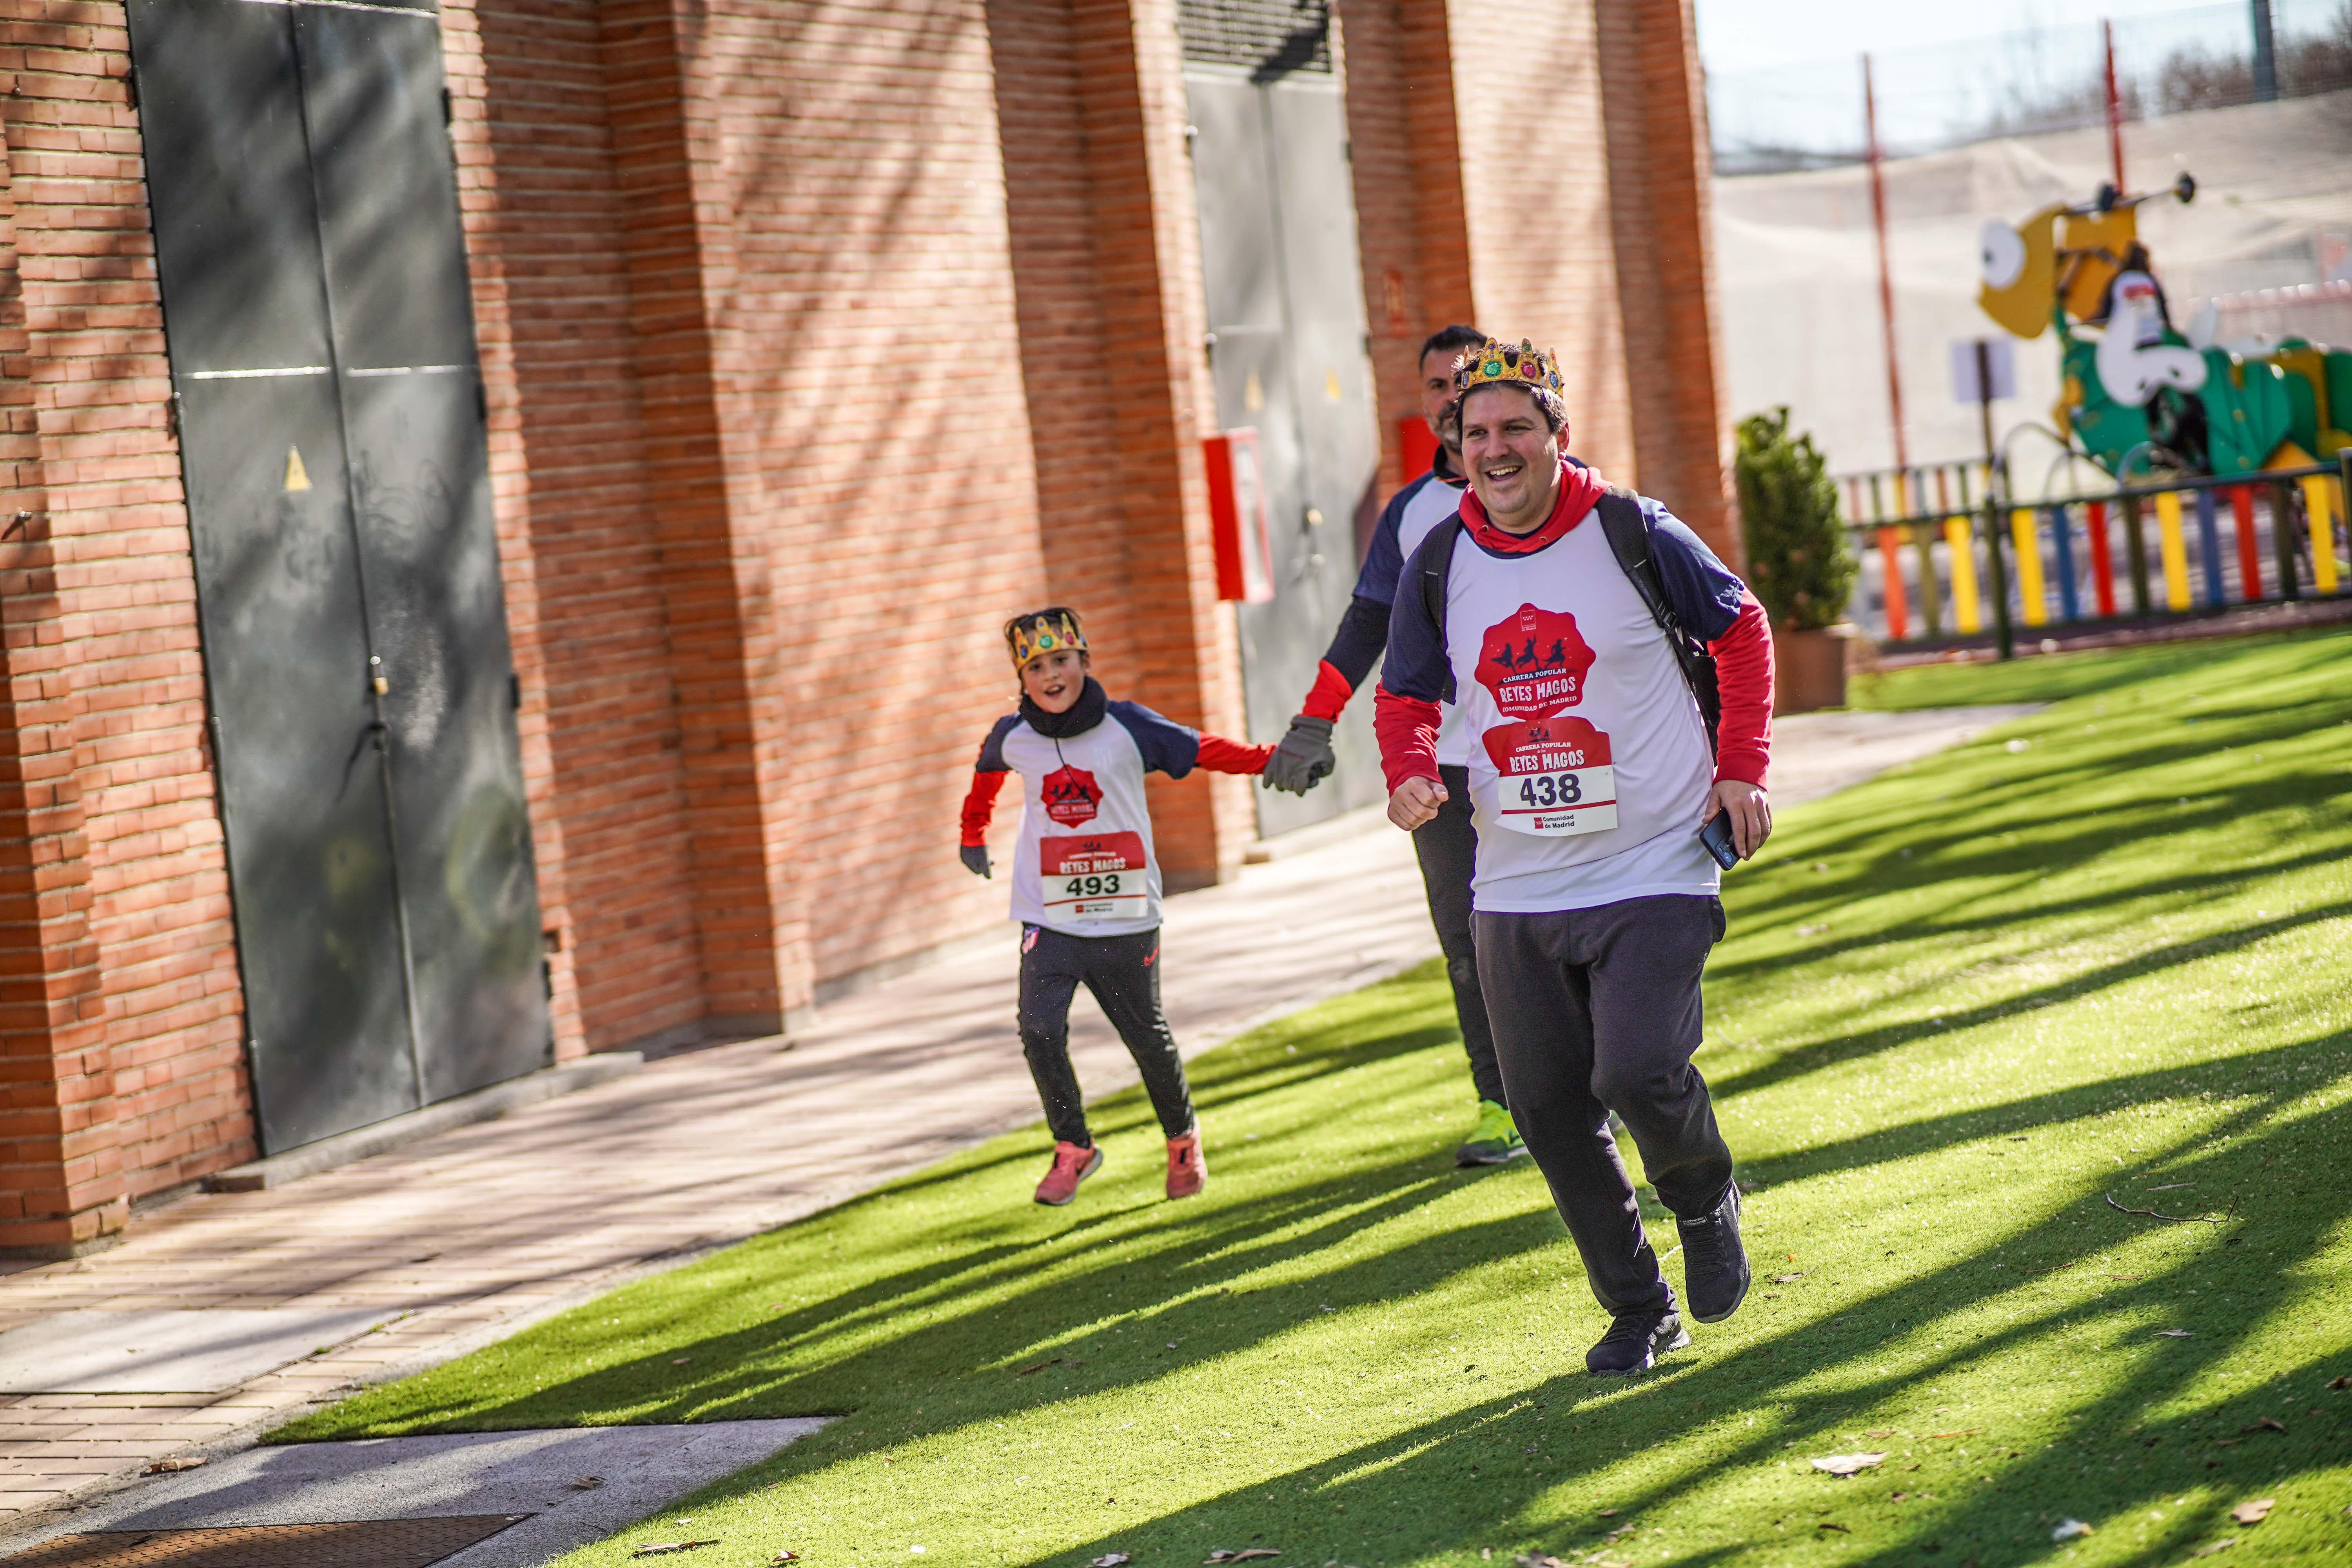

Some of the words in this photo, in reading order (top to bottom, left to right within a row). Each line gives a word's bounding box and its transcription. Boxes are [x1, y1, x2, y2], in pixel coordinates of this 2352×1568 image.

[1503, 673, 1534, 682] CARRERA
[1535, 668, 1566, 677] POPULAR
[1499, 686, 1532, 702] REYES
[1537, 677, 1576, 700] MAGOS
[1550, 696, 1577, 705] MADRID
[1509, 755, 1539, 773] REYES
[1542, 750, 1584, 770] MAGOS
[1520, 773, 1581, 806] 438
[1060, 861, 1090, 874] REYES
[1093, 857, 1126, 871] MAGOS
[1066, 874, 1119, 897] 493
